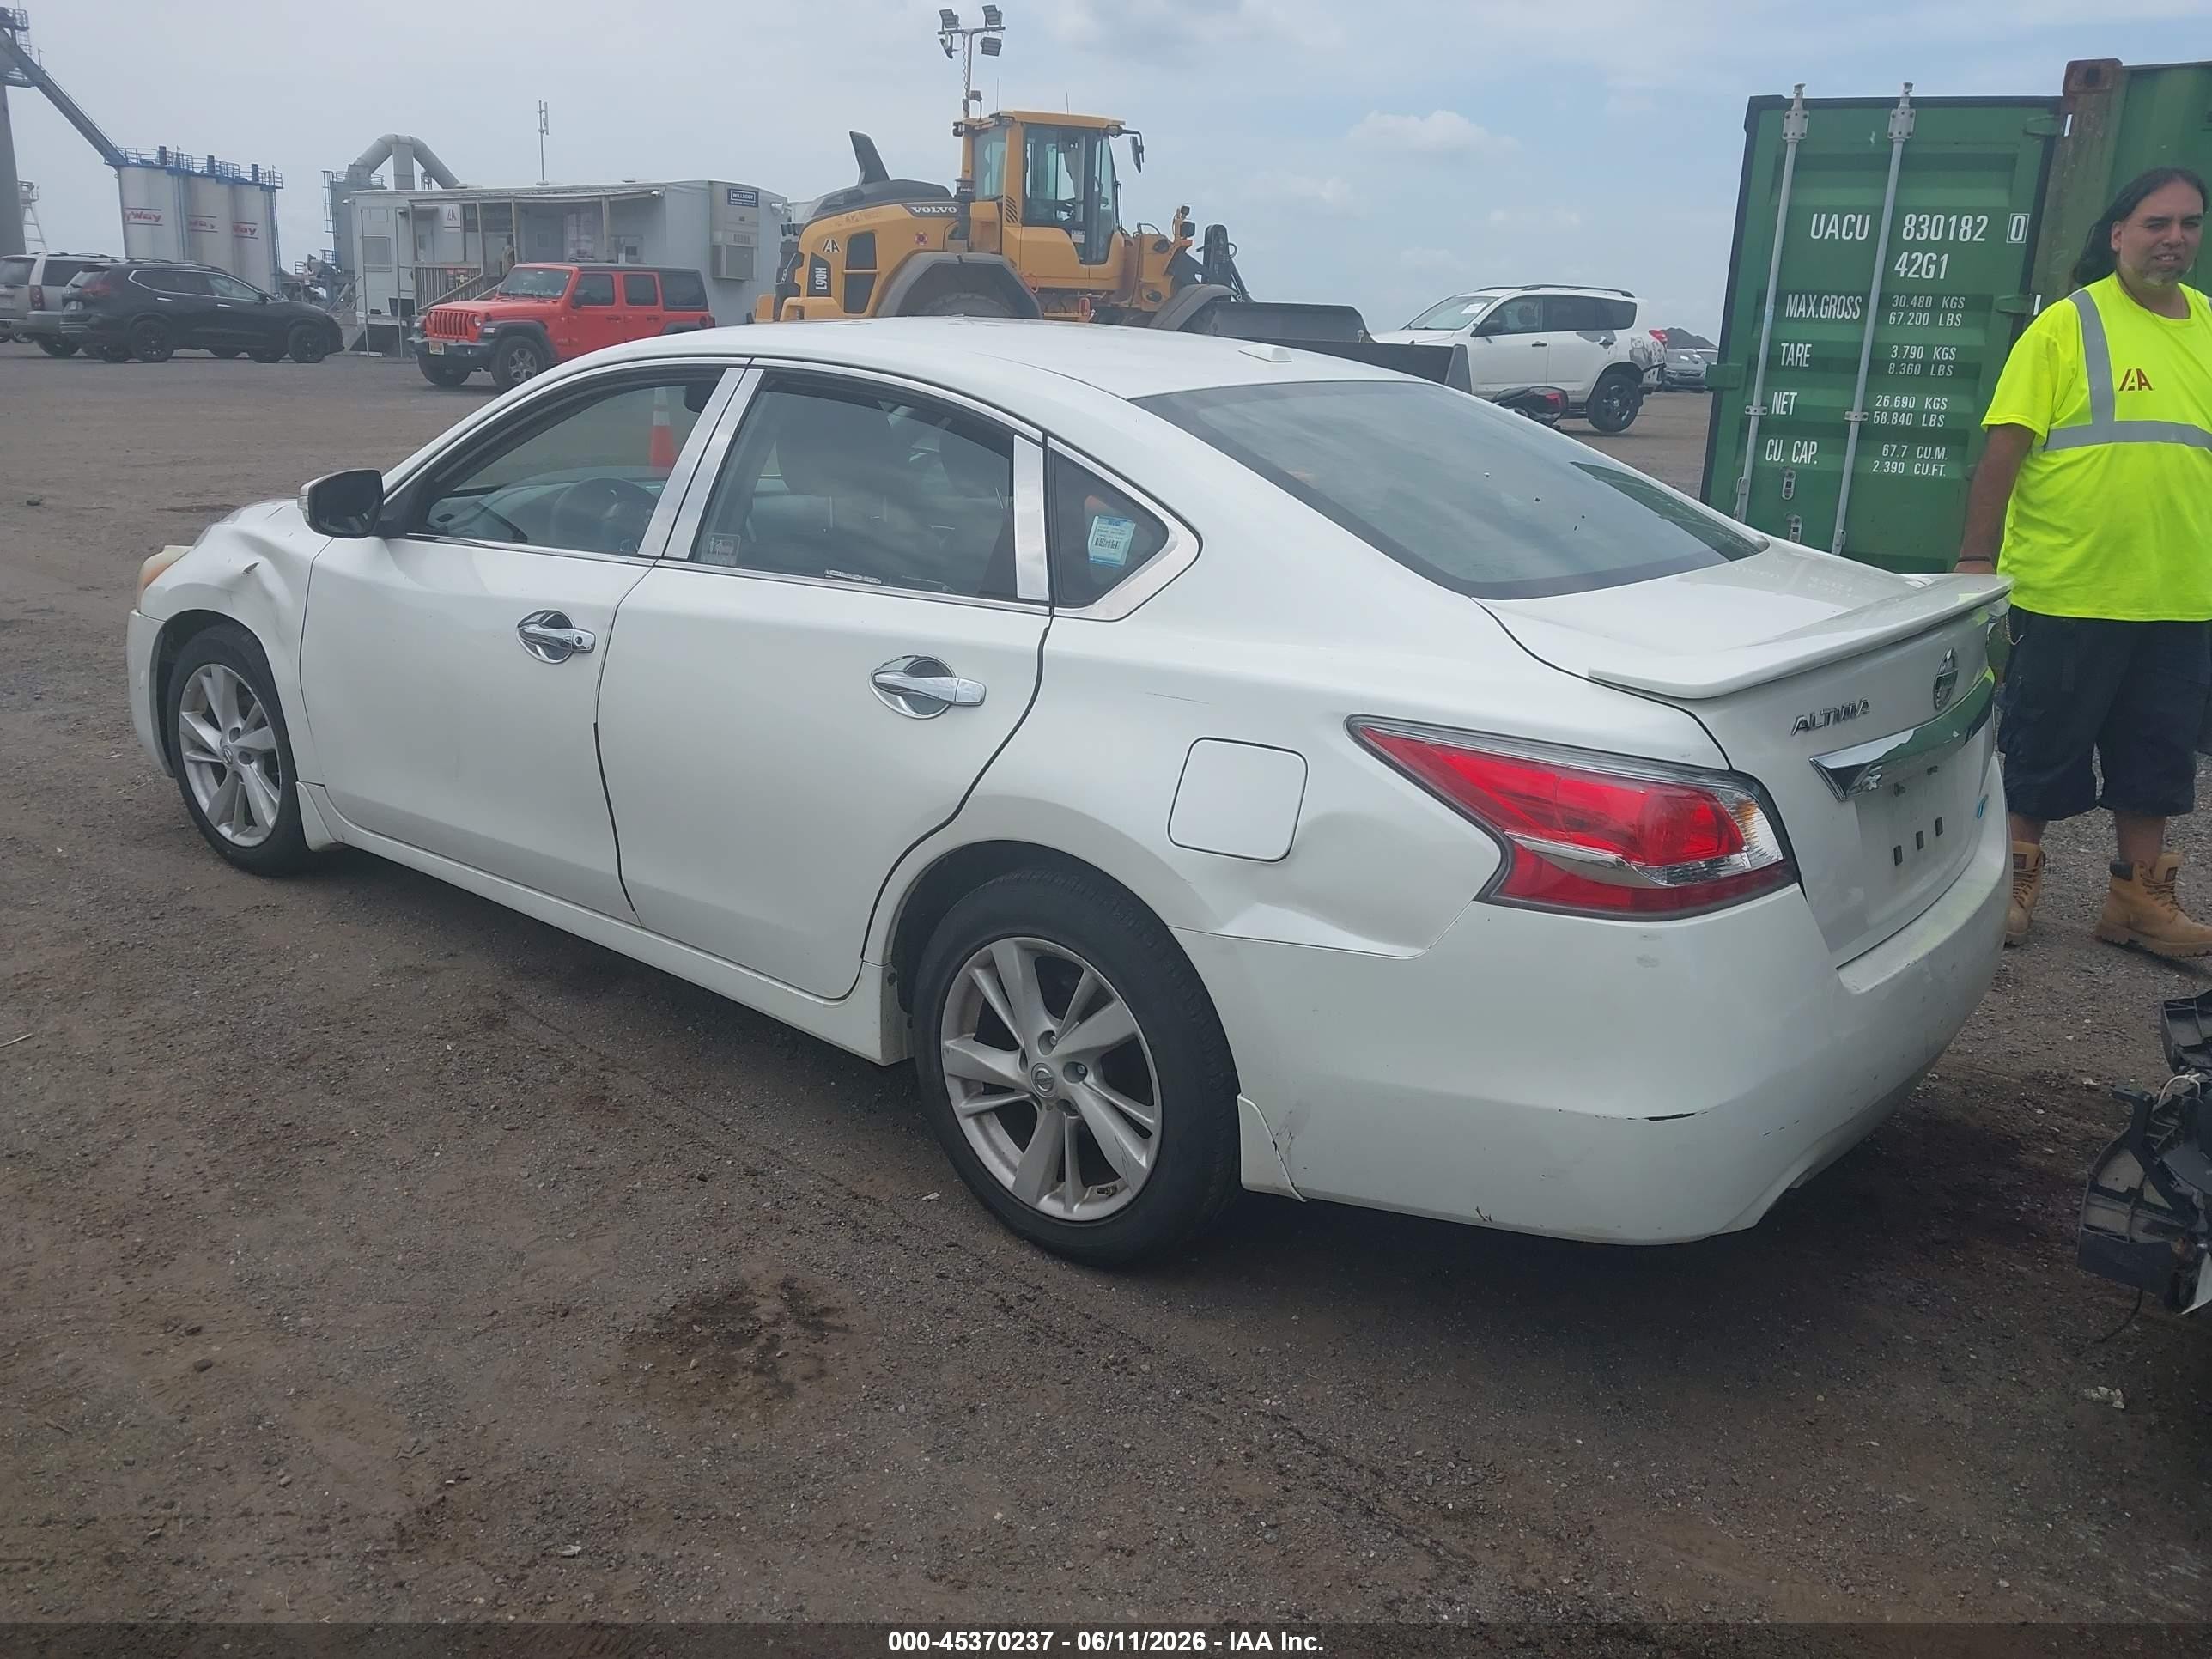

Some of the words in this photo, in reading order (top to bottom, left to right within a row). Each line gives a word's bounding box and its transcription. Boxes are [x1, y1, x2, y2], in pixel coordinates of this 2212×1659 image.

[1810, 213, 1871, 240] UACU
[1902, 213, 1989, 242] 830182
[2008, 214, 2027, 242] 0
[815, 267, 828, 289] L90H
[1894, 252, 1949, 279] 42G1
[1785, 294, 1863, 319] MAX.GROSS
[1891, 295, 1933, 308] 30.480
[1942, 296, 1966, 309] KGS
[1888, 312, 1930, 326] 67.200
[1938, 313, 1963, 327] LBS
[1781, 343, 1813, 368] TARE
[1891, 345, 1924, 360] 3.790
[1932, 346, 1957, 361] KGS
[1887, 362, 1922, 376] 8.360
[1929, 363, 1954, 377] LBS
[1771, 391, 1798, 416] NET
[1875, 394, 1916, 409] 26.690
[1924, 397, 1948, 410] KGS
[1873, 410, 1913, 426] 58.840
[1921, 413, 1945, 428] LBS
[1765, 438, 1785, 463] CU.
[1791, 441, 1819, 465] CAP.
[1881, 444, 1908, 458] 67.7
[1872, 460, 1905, 474] 2.390
[1790, 696, 1870, 736] ALTIMA
